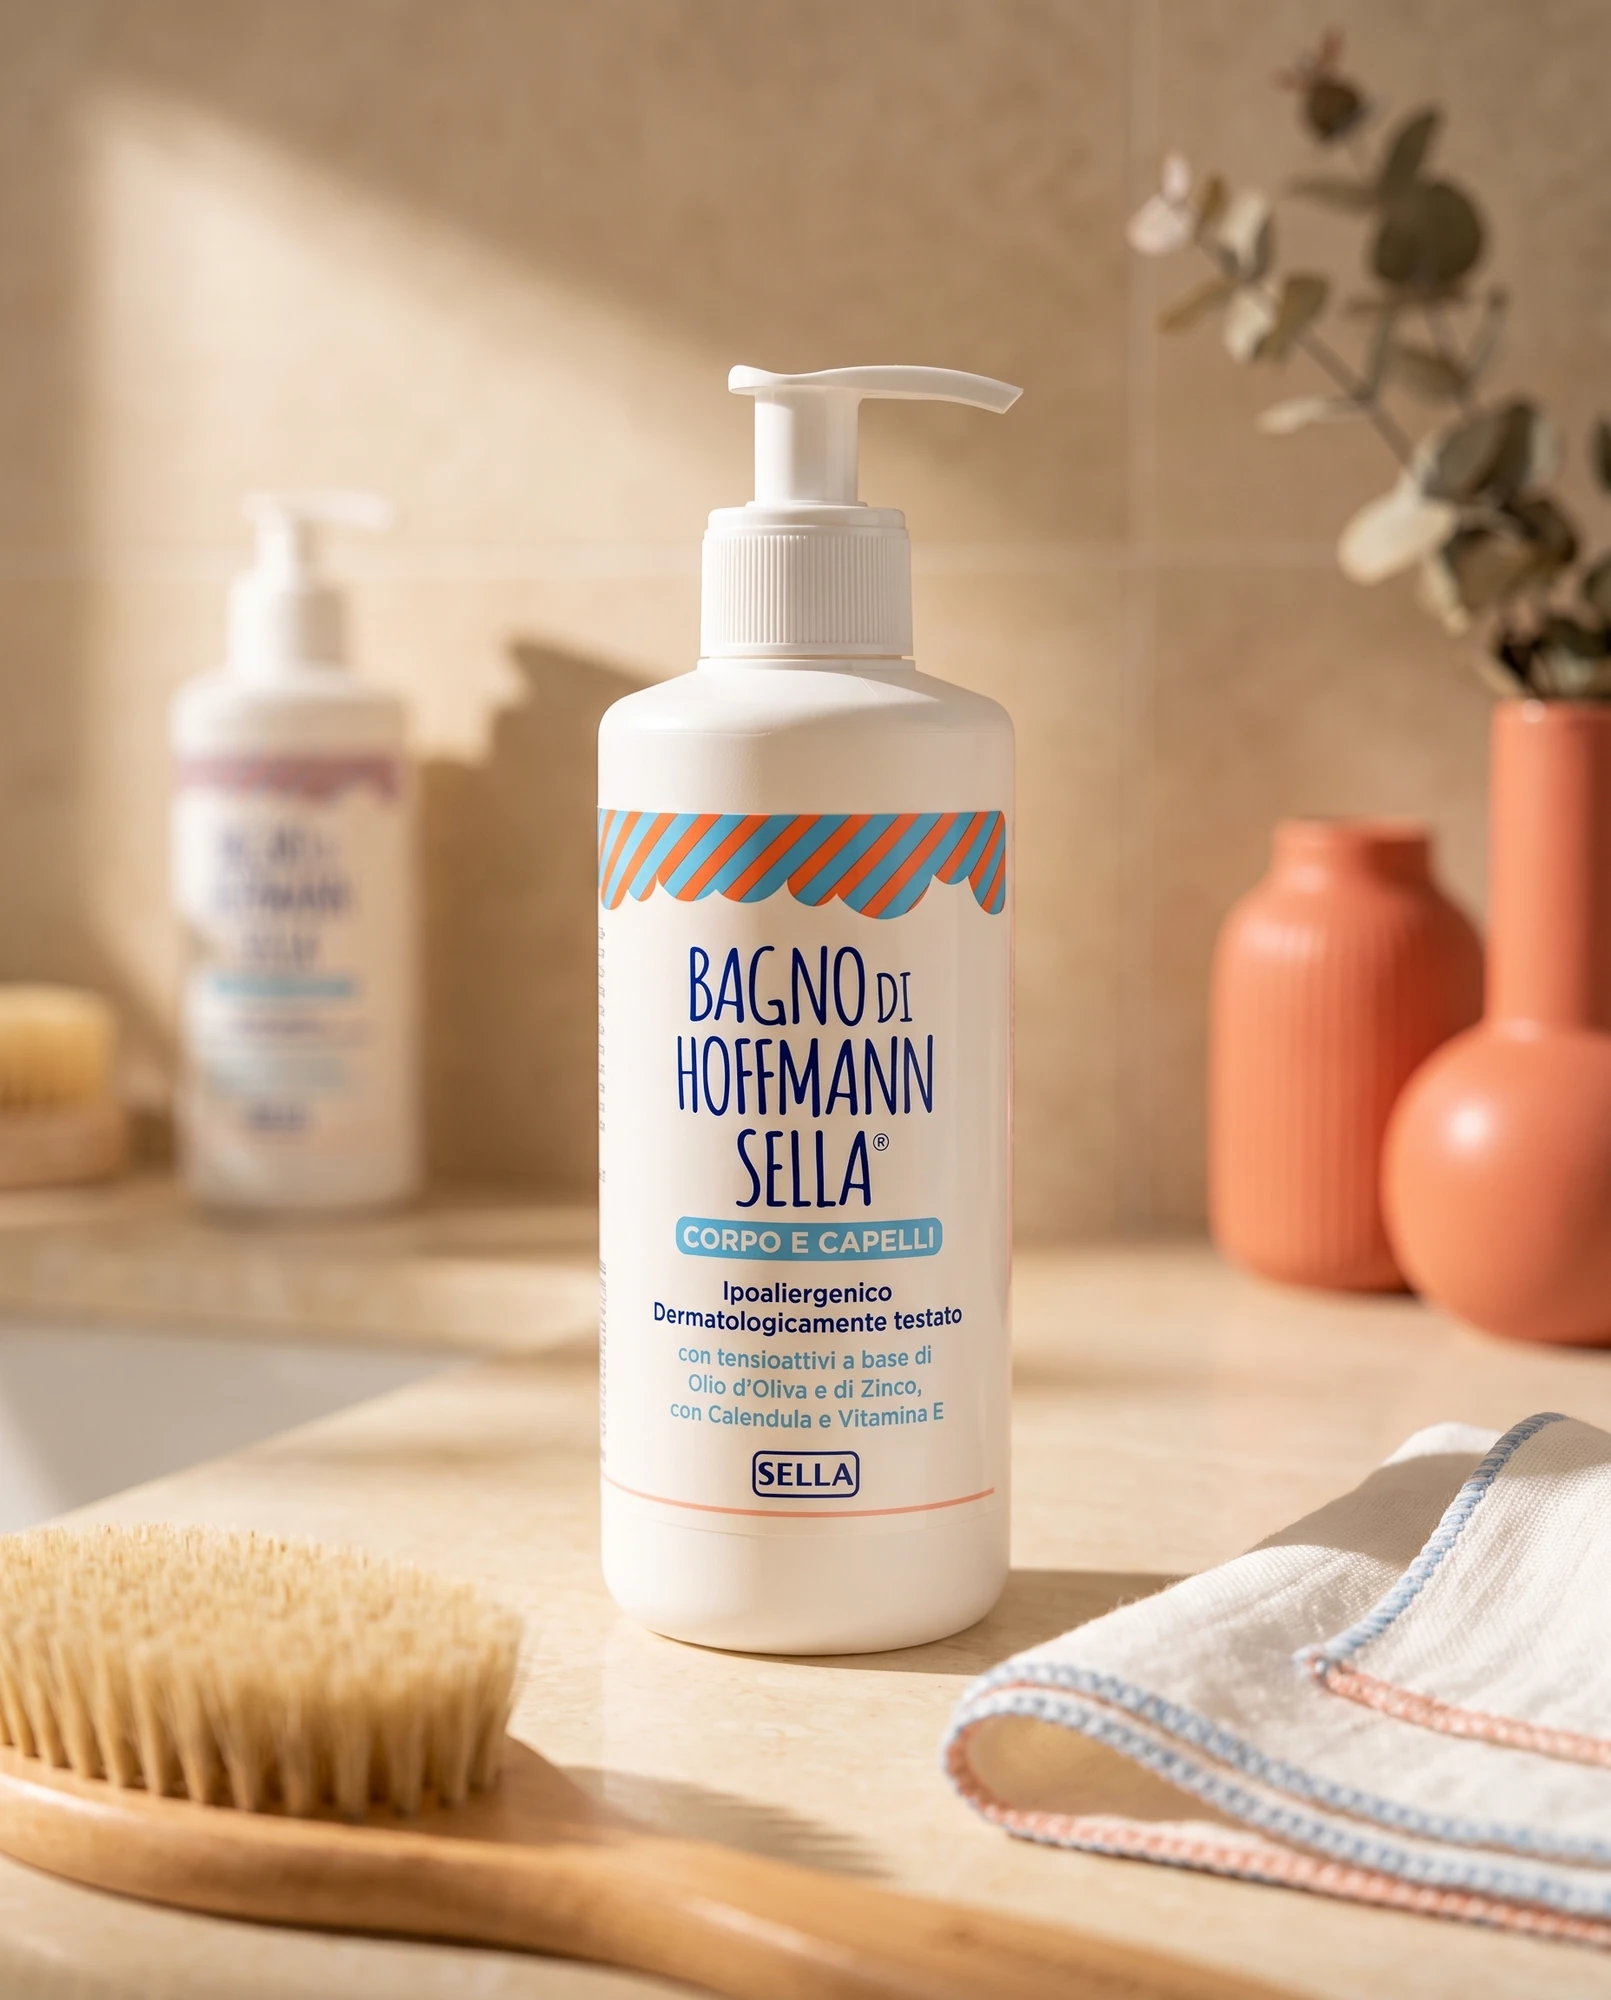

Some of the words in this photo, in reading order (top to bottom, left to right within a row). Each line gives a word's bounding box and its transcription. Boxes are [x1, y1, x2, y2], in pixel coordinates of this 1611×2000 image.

[689, 945, 866, 1027] BAGNO
[876, 971, 913, 1023] DI
[677, 1034, 934, 1118] HOFFMANN
[683, 1225, 782, 1254] CORPO
[792, 1231, 809, 1254] E
[818, 1227, 934, 1254] CAPELLI
[654, 1301, 887, 1336] Dermatologicamente
[893, 1307, 963, 1330] testato
[678, 1347, 711, 1365] con
[717, 1348, 836, 1371] tensioattivi
[843, 1355, 855, 1370] a
[861, 1349, 909, 1369] base
[914, 1345, 932, 1365] di
[688, 1374, 726, 1396] Olio
[814, 1384, 827, 1400] e
[833, 1379, 854, 1399] di
[860, 1378, 923, 1399] Zinco,
[670, 1402, 702, 1422] con
[708, 1405, 813, 1429] Calendula
[819, 1413, 831, 1429] e
[838, 1404, 928, 1428] Vitamina
[933, 1402, 944, 1421] E
[757, 1461, 854, 1487] SELLA
